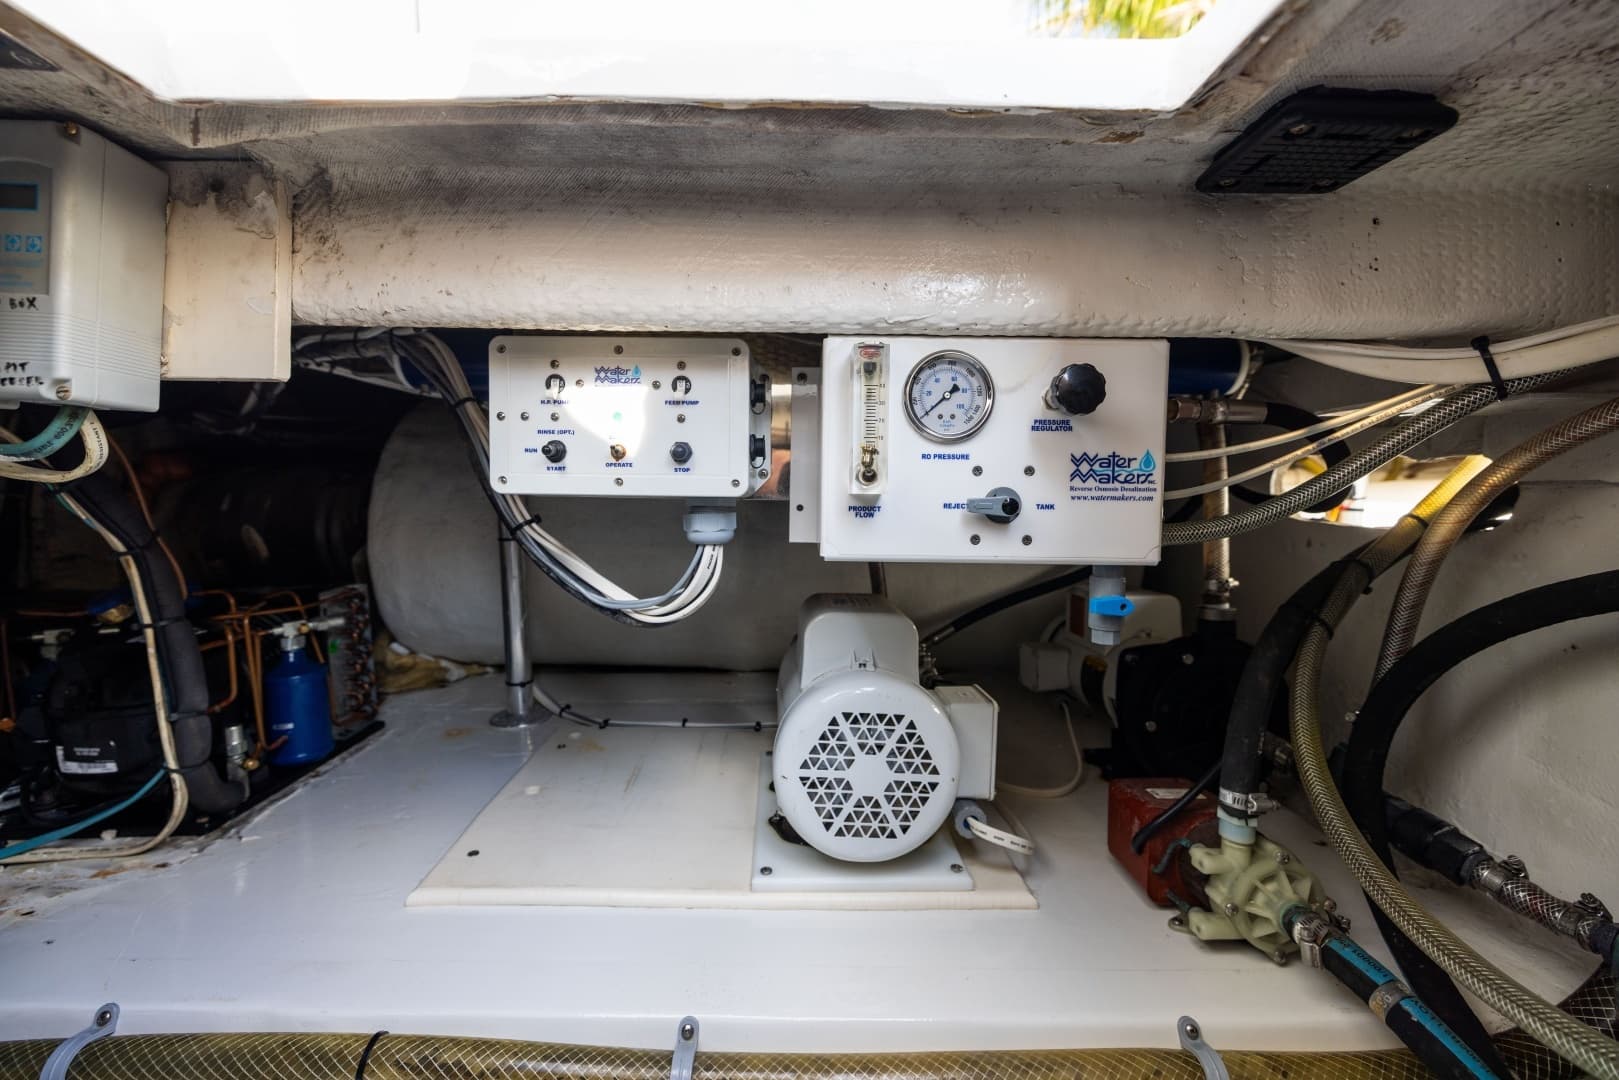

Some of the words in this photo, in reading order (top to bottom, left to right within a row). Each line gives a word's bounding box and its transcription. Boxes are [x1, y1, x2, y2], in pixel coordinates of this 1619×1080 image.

[9, 297, 38, 310] BOX
[594, 365, 631, 376] Water
[1070, 451, 1138, 468] Water
[1070, 468, 1154, 485] Makers
[1070, 494, 1154, 502] www.watermakers.com
